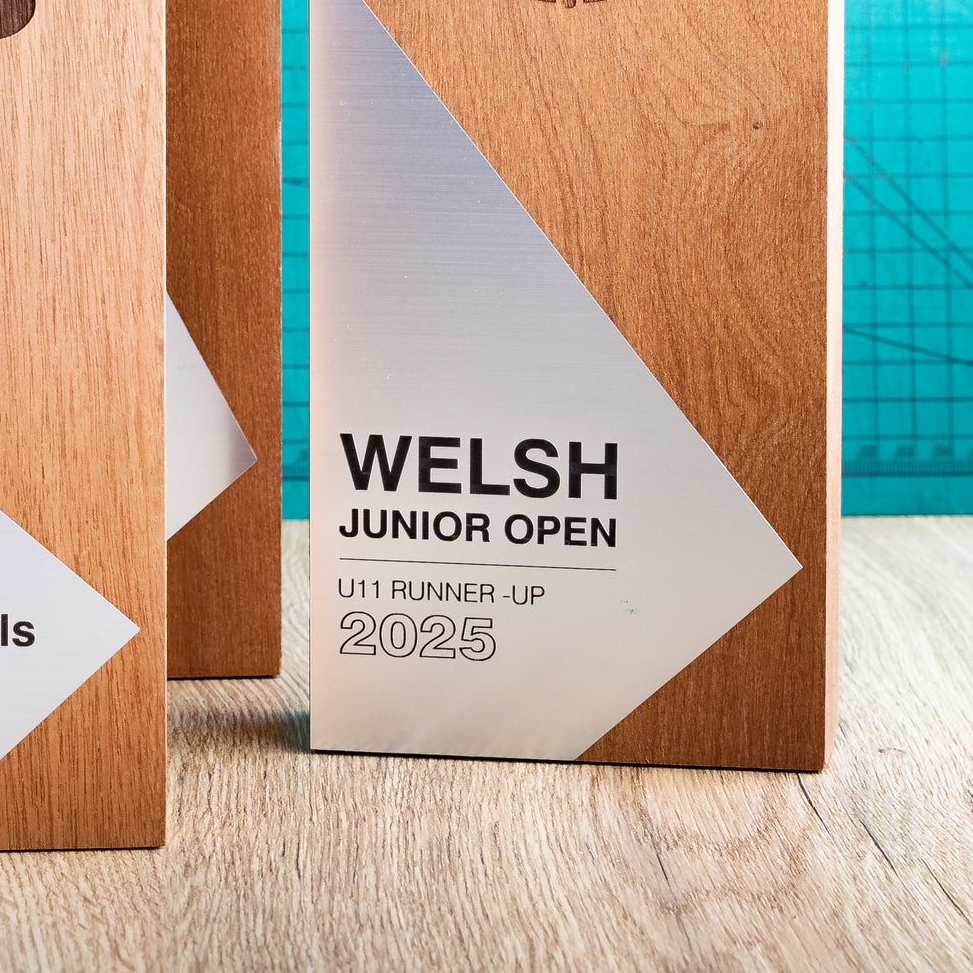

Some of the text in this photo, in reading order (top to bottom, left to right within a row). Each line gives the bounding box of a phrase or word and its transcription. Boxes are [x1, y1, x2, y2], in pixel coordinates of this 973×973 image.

[339, 433, 619, 500] WELSH
[338, 508, 617, 547] JUNIOR OPEN
[338, 578, 380, 600] U11
[391, 580, 495, 604] RUNNER
[339, 611, 497, 662] 2025
